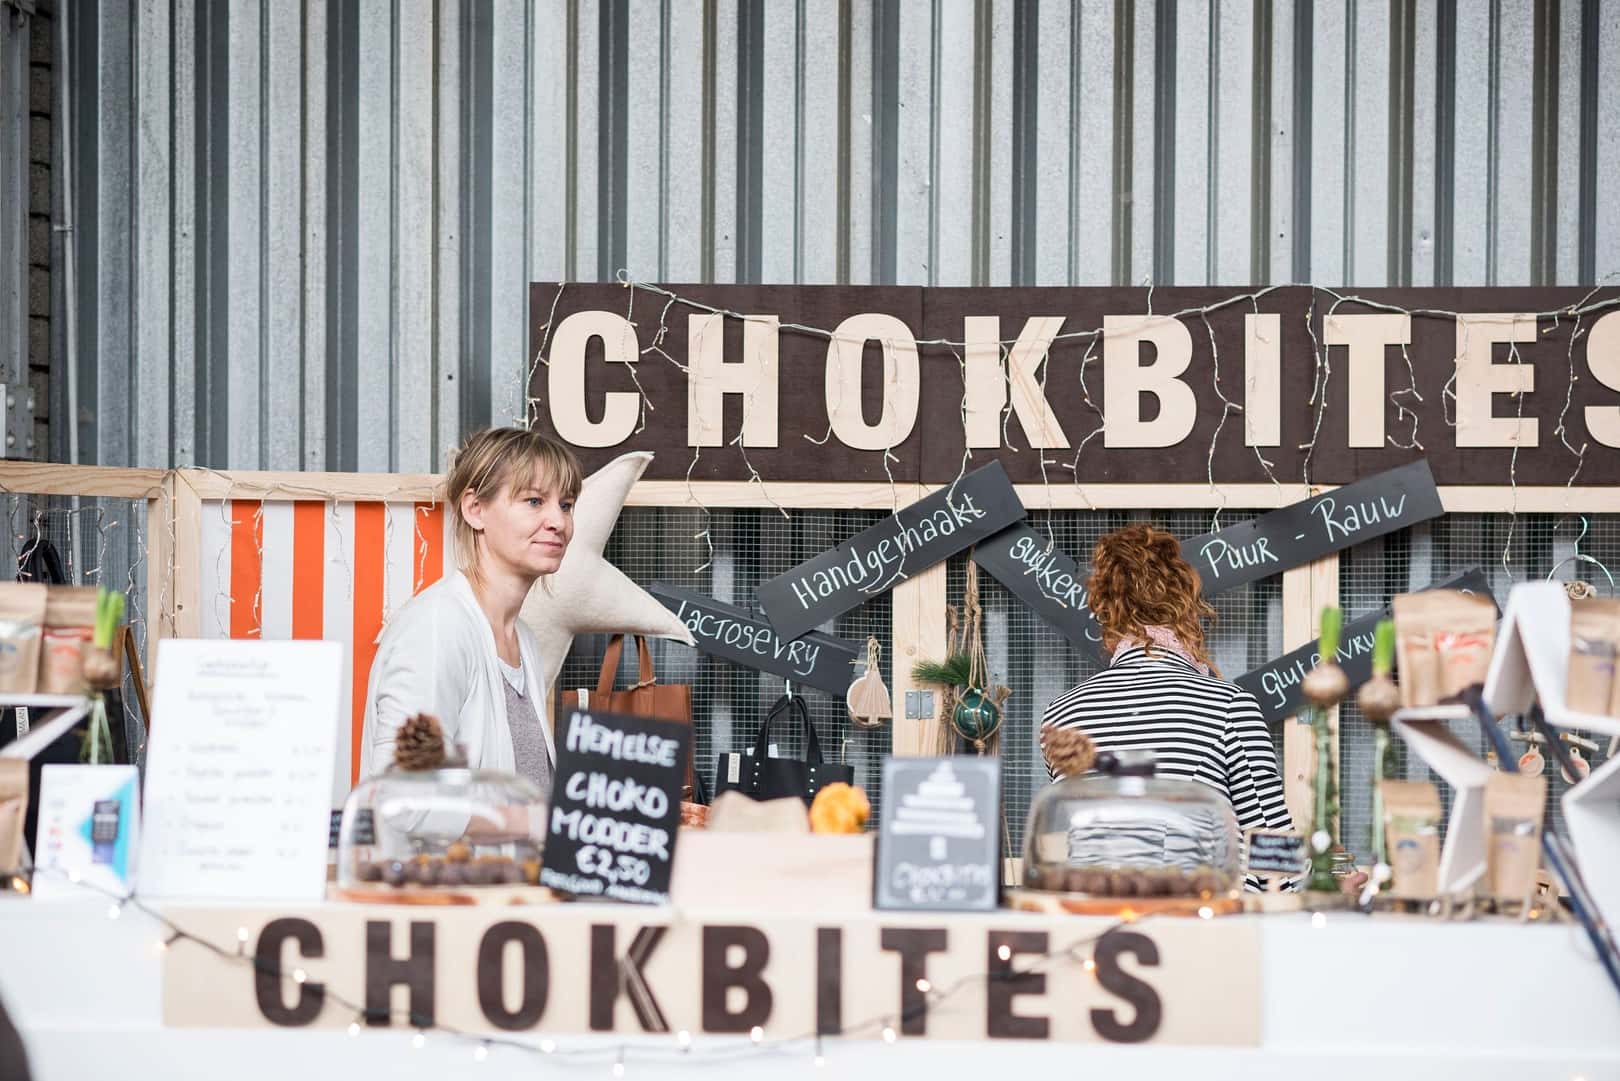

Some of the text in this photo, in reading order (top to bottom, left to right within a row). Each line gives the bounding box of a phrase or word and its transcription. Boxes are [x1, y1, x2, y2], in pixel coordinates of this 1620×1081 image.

[1310, 493, 1406, 543] Rauw
[791, 492, 987, 609] Handgemaakt
[566, 712, 680, 768] HEMELSE
[565, 771, 669, 819] CHOKO
[551, 806, 669, 862] MODDER
[576, 845, 650, 886] €2,50
[253, 917, 1163, 1044] CHOKBITES
